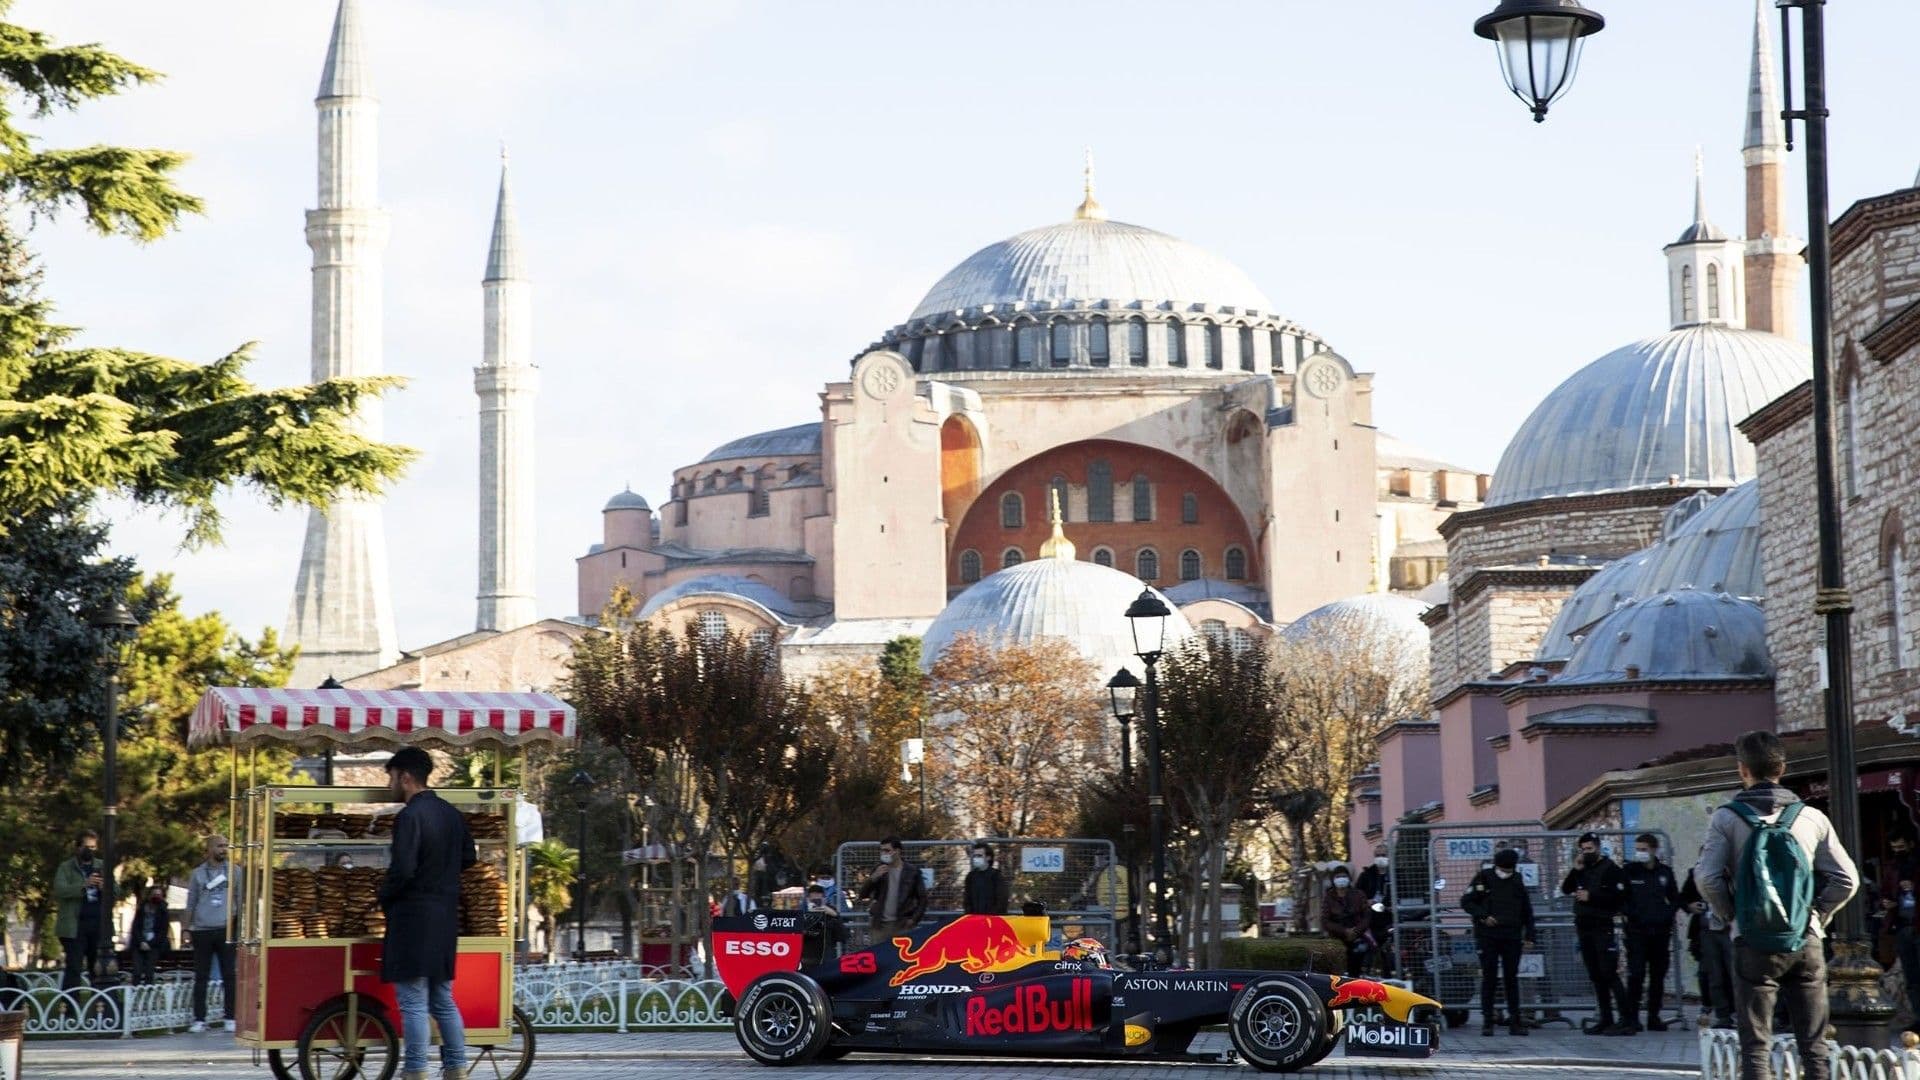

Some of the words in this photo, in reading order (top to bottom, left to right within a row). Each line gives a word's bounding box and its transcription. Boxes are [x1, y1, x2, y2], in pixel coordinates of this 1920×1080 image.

[1449, 840, 1490, 854] POLIS
[1027, 855, 1061, 868] OLIS
[770, 917, 797, 928] AT&T
[725, 940, 790, 956] ESSO
[840, 952, 877, 974] 23
[1054, 961, 1082, 971] citrix
[899, 984, 973, 995] HONDA
[1124, 978, 1169, 991] ASTON
[1174, 980, 1229, 992] MARTIN
[1348, 1025, 1406, 1045] Mobil
